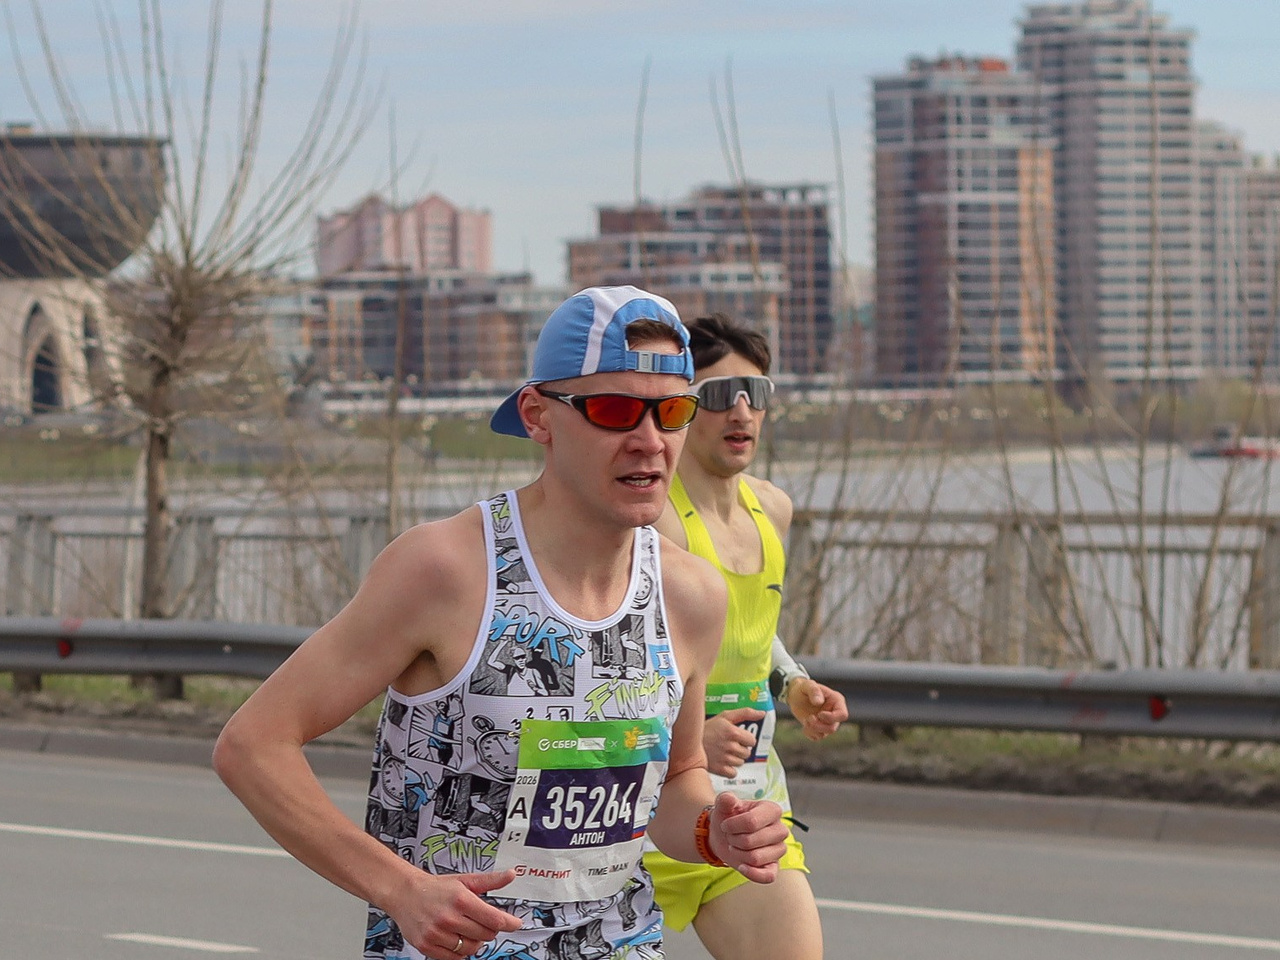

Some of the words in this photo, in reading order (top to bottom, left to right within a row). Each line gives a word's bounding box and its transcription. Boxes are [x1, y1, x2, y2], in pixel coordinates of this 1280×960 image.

[551, 739, 577, 749] СБЕР
[517, 775, 538, 785] 2026
[541, 782, 637, 831] 35264
[569, 831, 606, 846] АНТОН
[528, 869, 572, 879] МАГНИТ
